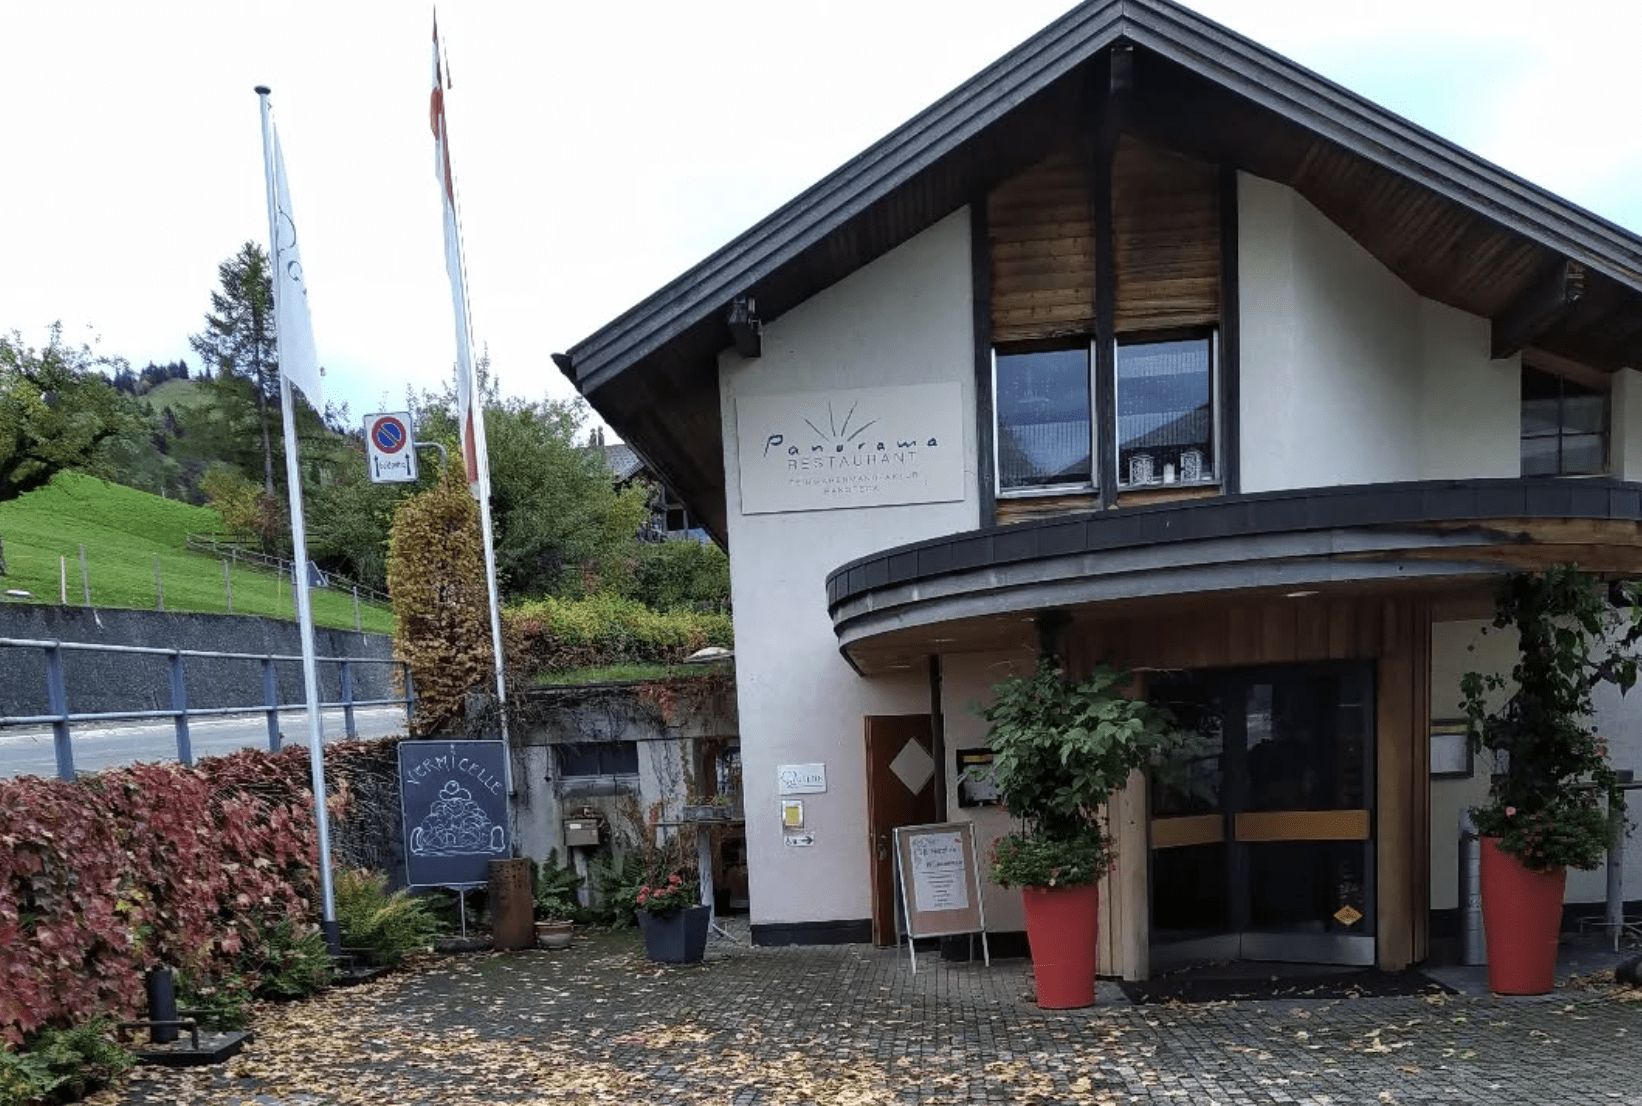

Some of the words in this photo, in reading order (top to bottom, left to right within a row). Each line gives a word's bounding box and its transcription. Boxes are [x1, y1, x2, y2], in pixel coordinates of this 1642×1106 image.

[764, 434, 938, 457] Panorama
[787, 451, 917, 470] RESTAURANT
[407, 744, 502, 796] VERMICELLE
